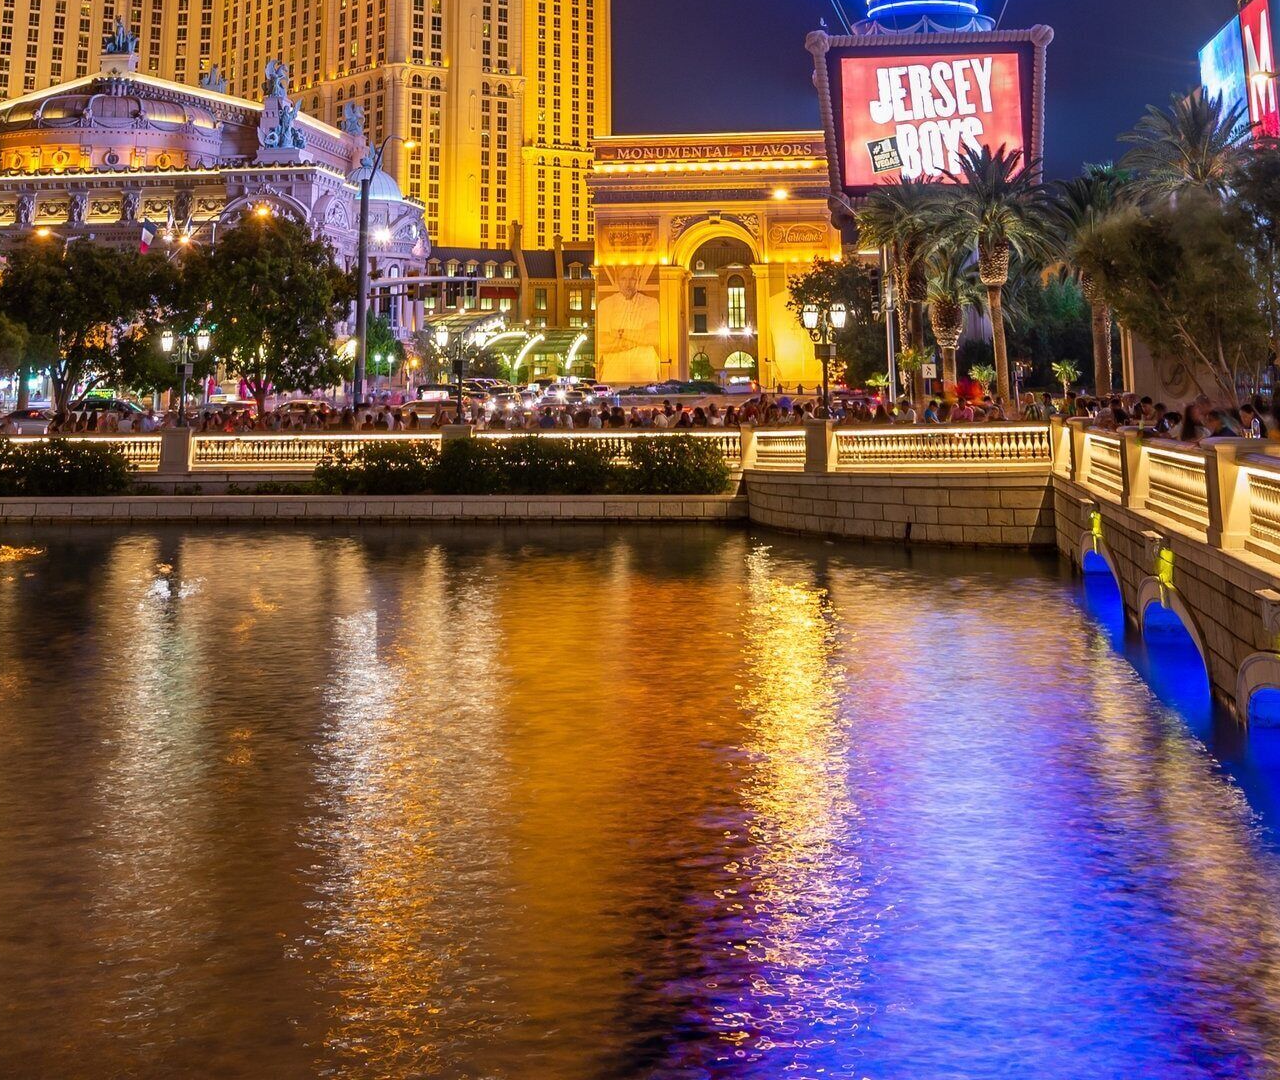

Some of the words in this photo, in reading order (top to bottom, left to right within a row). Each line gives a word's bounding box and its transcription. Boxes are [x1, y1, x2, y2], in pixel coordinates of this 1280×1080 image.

[870, 57, 993, 124] JERSEY
[1244, 9, 1276, 123] M
[616, 146, 733, 160] MONUMENTAL
[742, 144, 812, 157] FLAVORS
[875, 156, 900, 168] VEGAS
[896, 117, 984, 179] BOYS
